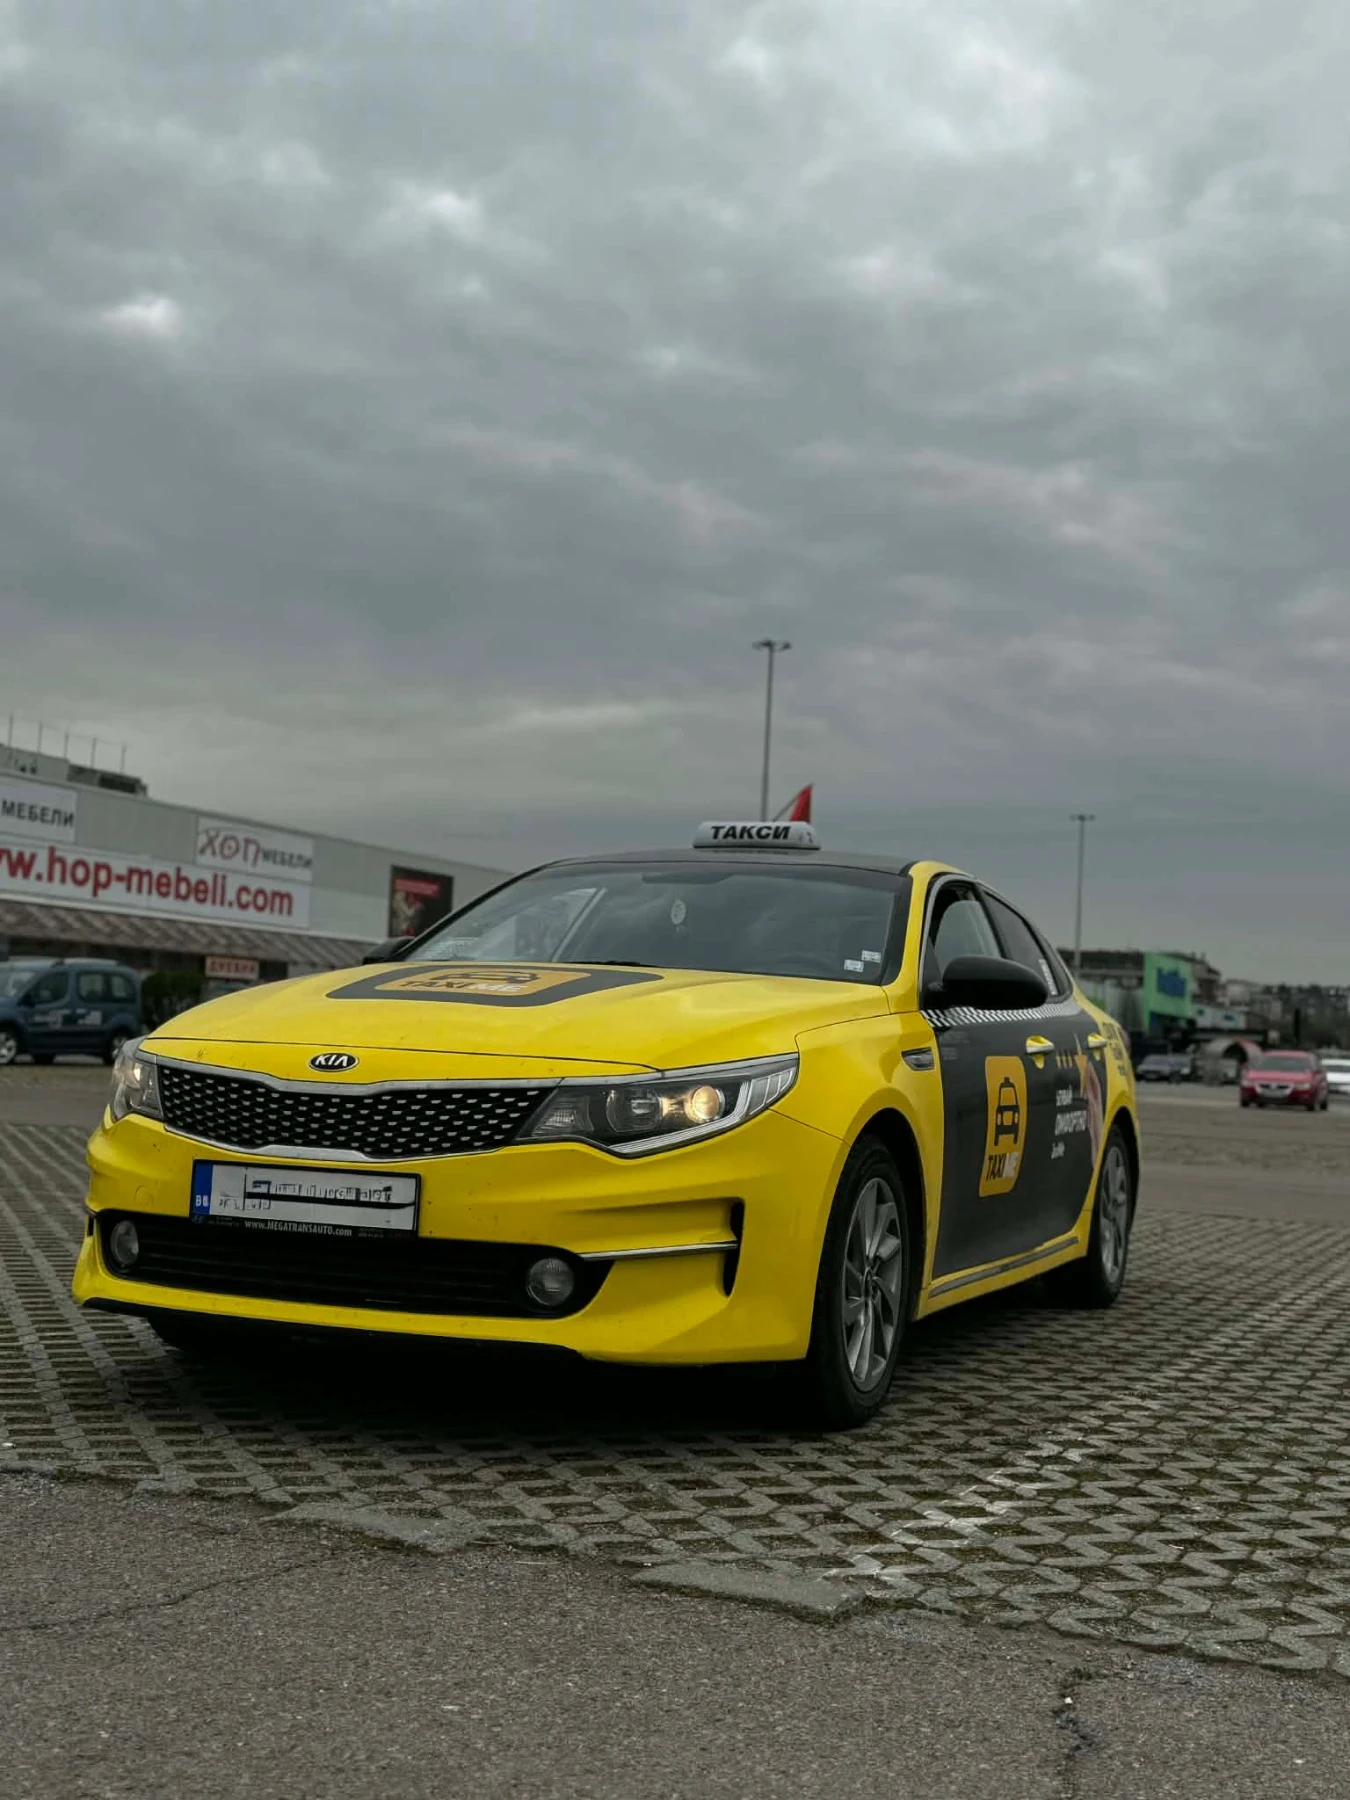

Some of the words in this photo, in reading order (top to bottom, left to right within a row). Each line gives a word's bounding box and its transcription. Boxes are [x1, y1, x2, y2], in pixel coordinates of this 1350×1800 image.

[2, 800, 74, 828] МЕБЕЛИ
[711, 825, 791, 840] ТАКСИ
[315, 1054, 349, 1067] KIA
[244, 1219, 352, 1237] www.MEGATRANSAUTO.com
